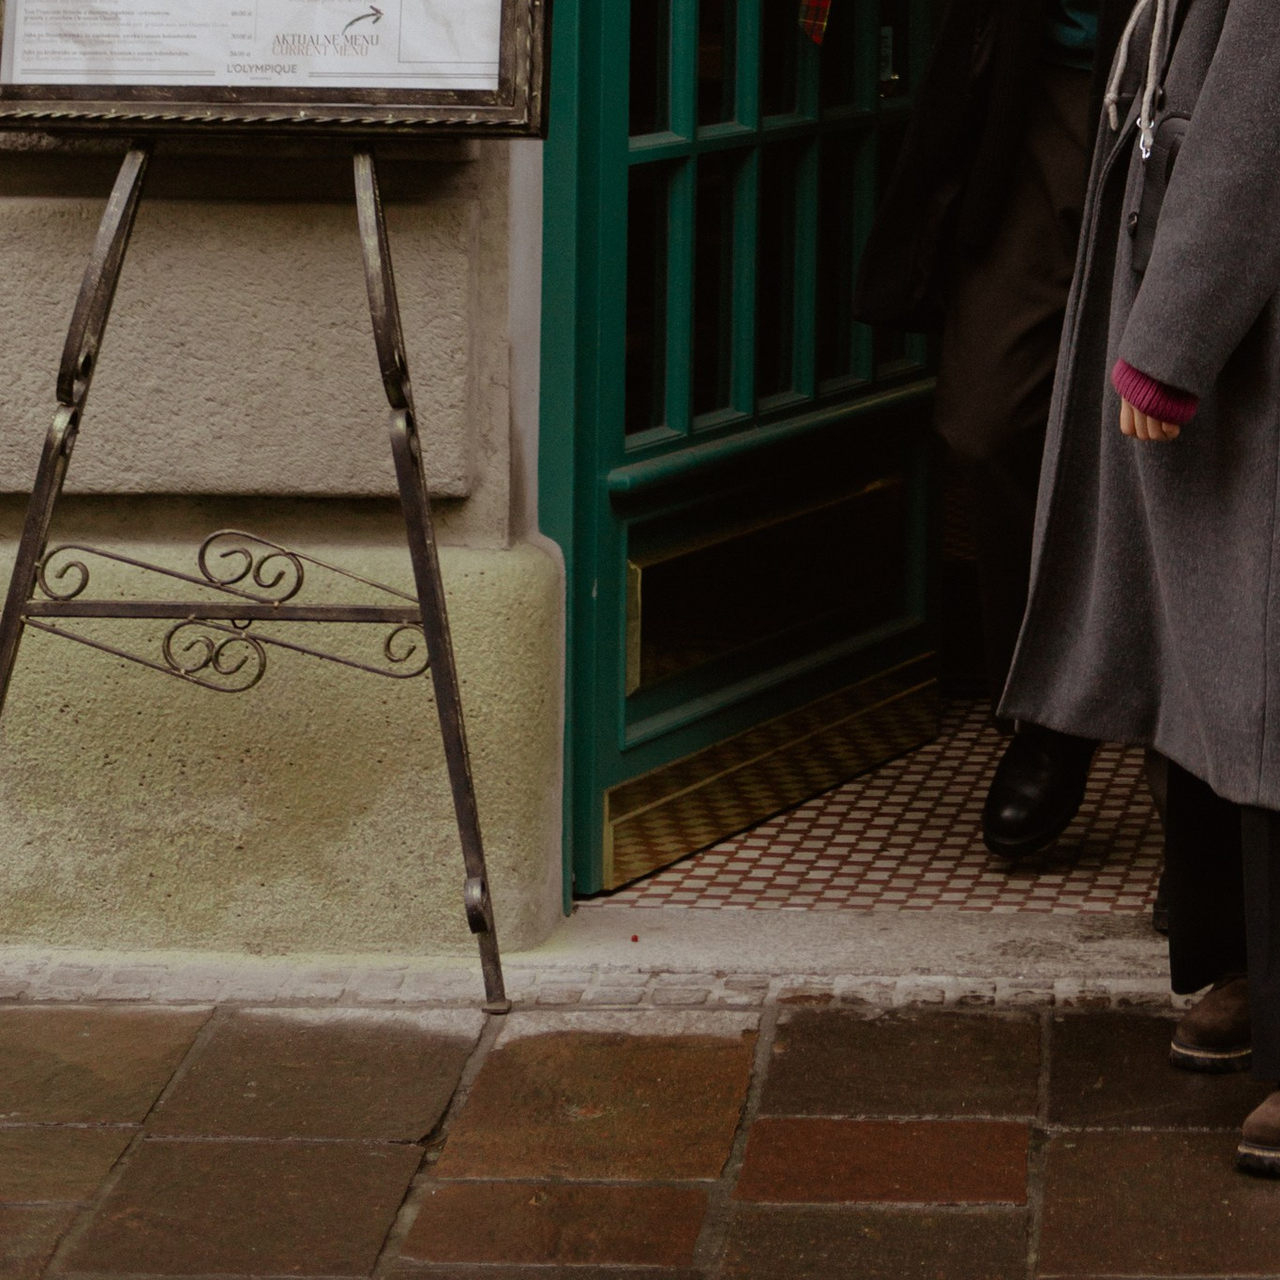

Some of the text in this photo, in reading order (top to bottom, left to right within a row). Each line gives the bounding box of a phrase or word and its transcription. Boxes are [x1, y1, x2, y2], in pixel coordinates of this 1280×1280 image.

[275, 34, 379, 46] AKTUALNE MENU
[272, 45, 369, 57] CURRENT MENU
